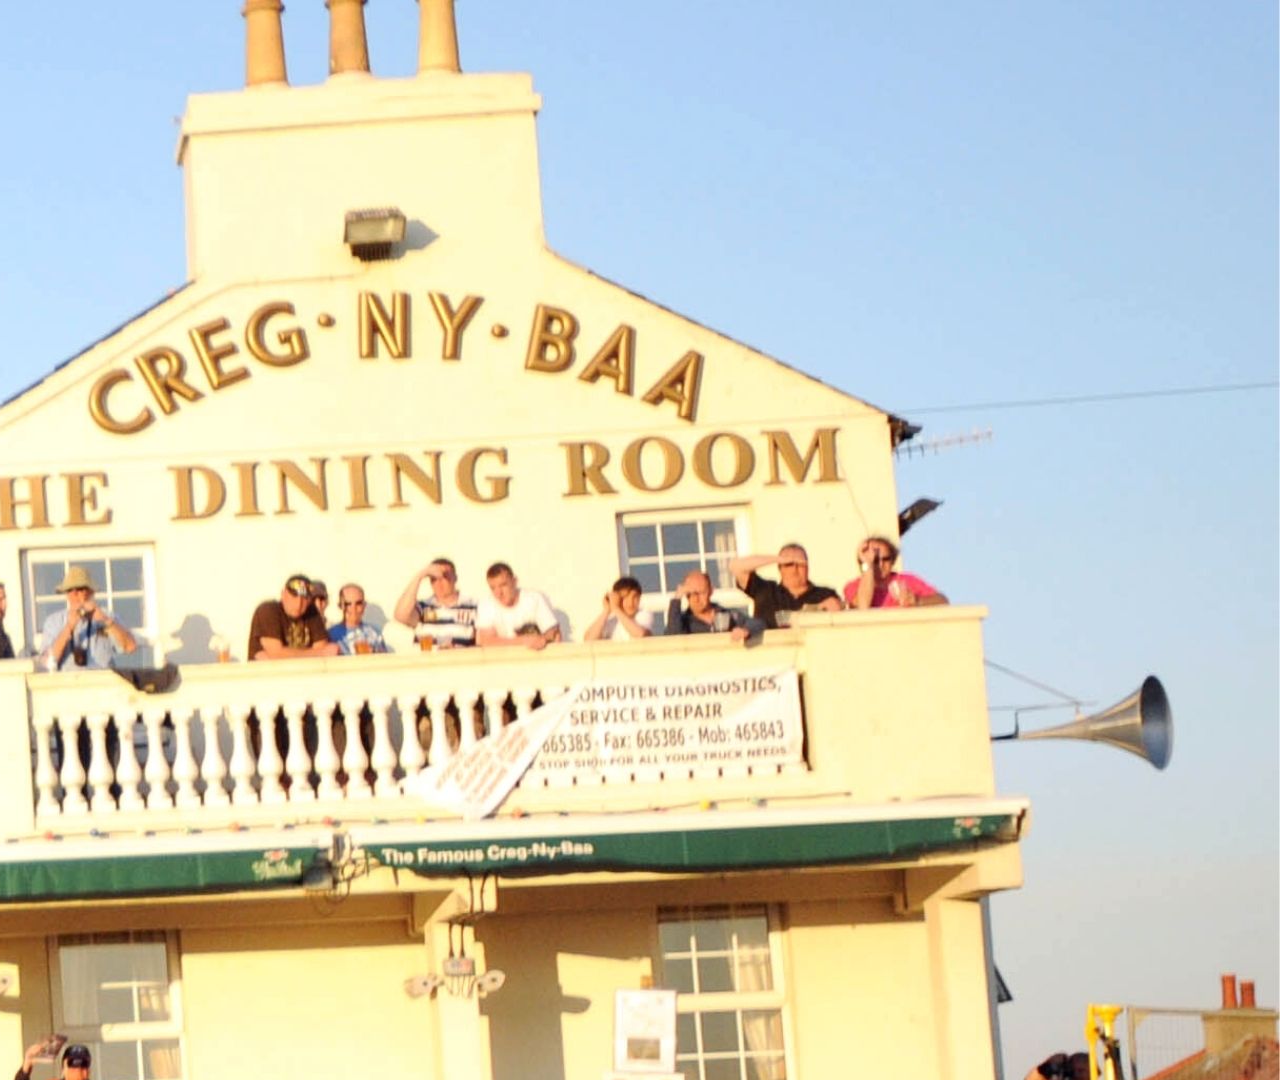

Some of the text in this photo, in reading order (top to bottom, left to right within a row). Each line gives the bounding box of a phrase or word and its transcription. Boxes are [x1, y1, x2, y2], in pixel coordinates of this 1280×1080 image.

[87, 291, 705, 434] CREG NY BAA
[168, 446, 513, 522] DINING
[559, 427, 844, 499] ROOM
[575, 688, 658, 704] OMPUTER
[570, 703, 722, 726] SERVICE & REPAIR
[604, 732, 632, 750] Fax:
[637, 728, 685, 748] 665386
[699, 725, 731, 745] Mob:
[735, 720, 784, 742] 465843
[382, 847, 413, 864] The
[417, 846, 484, 864] Famous
